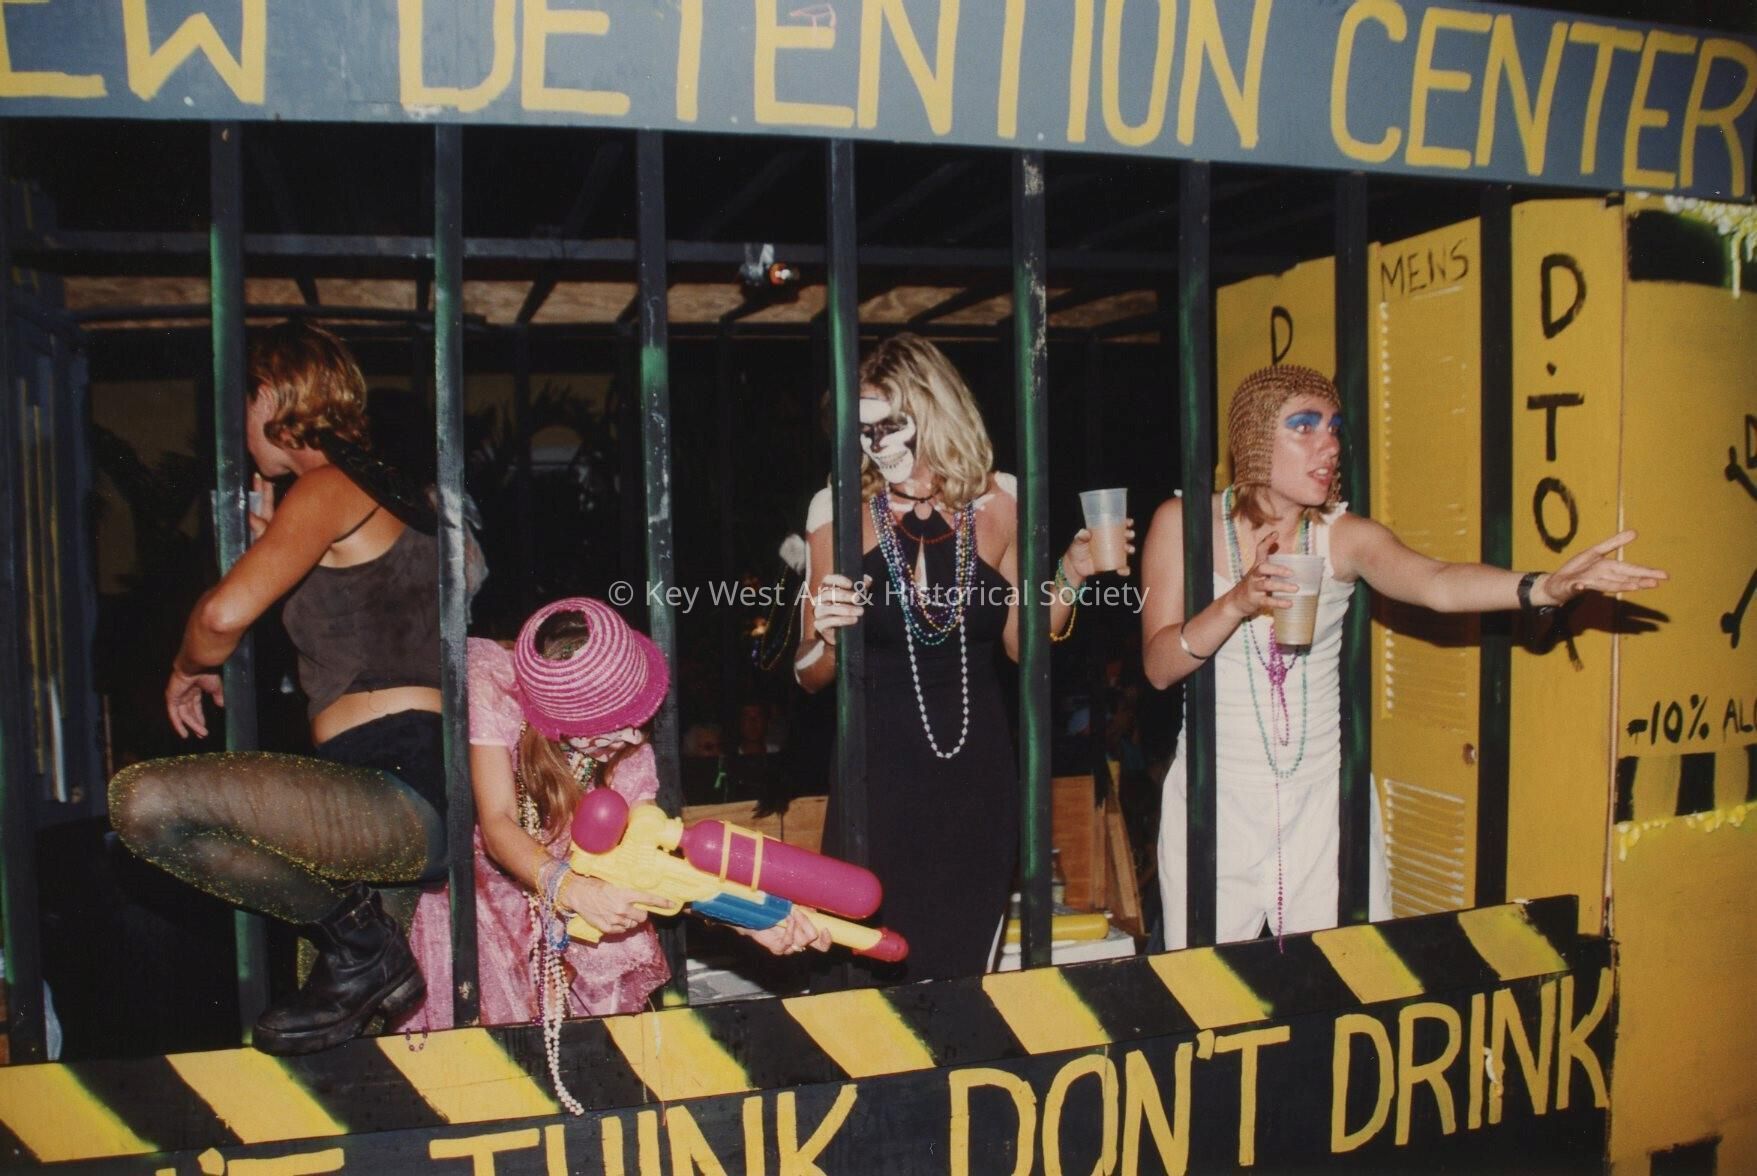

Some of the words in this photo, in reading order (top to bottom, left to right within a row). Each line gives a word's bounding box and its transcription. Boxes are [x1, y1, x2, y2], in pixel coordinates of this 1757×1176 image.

[399, 0, 1274, 149] DETENTION
[1331, 0, 1757, 197] CENTER
[1381, 237, 1469, 302] MENS
[949, 1026, 1290, 1176] DON'T
[1331, 967, 1614, 1154] DRINK
